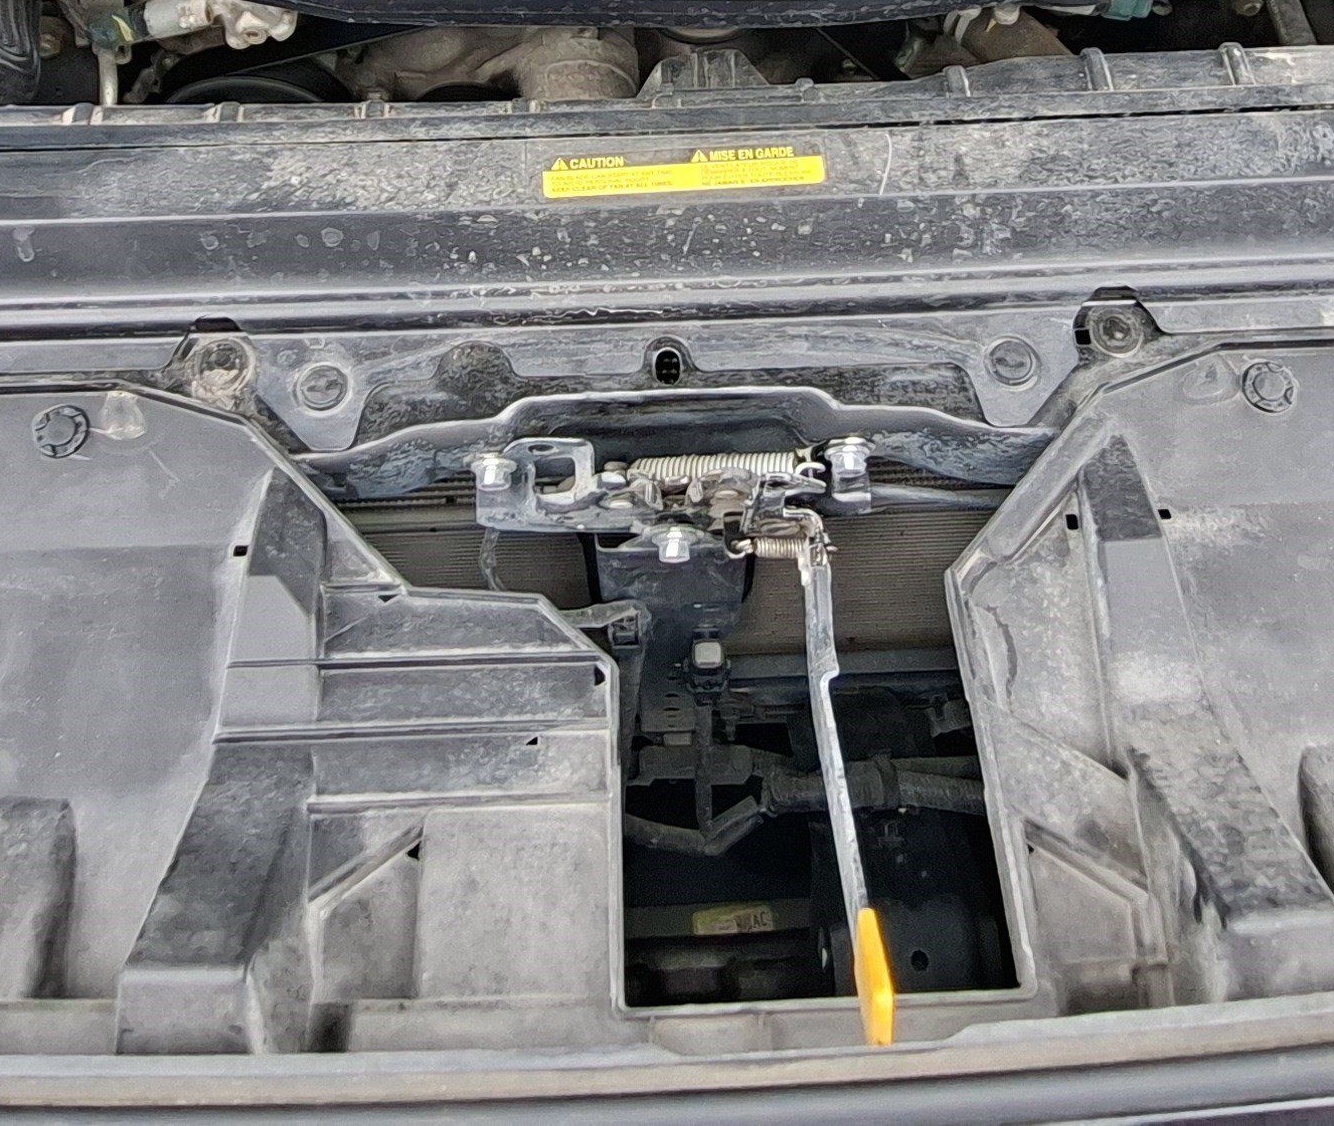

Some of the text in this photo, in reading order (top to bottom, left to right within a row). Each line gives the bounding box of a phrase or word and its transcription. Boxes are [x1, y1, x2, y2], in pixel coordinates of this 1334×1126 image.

[709, 146, 794, 162] MISE EN GARDE
[569, 156, 625, 170] CAUTION
